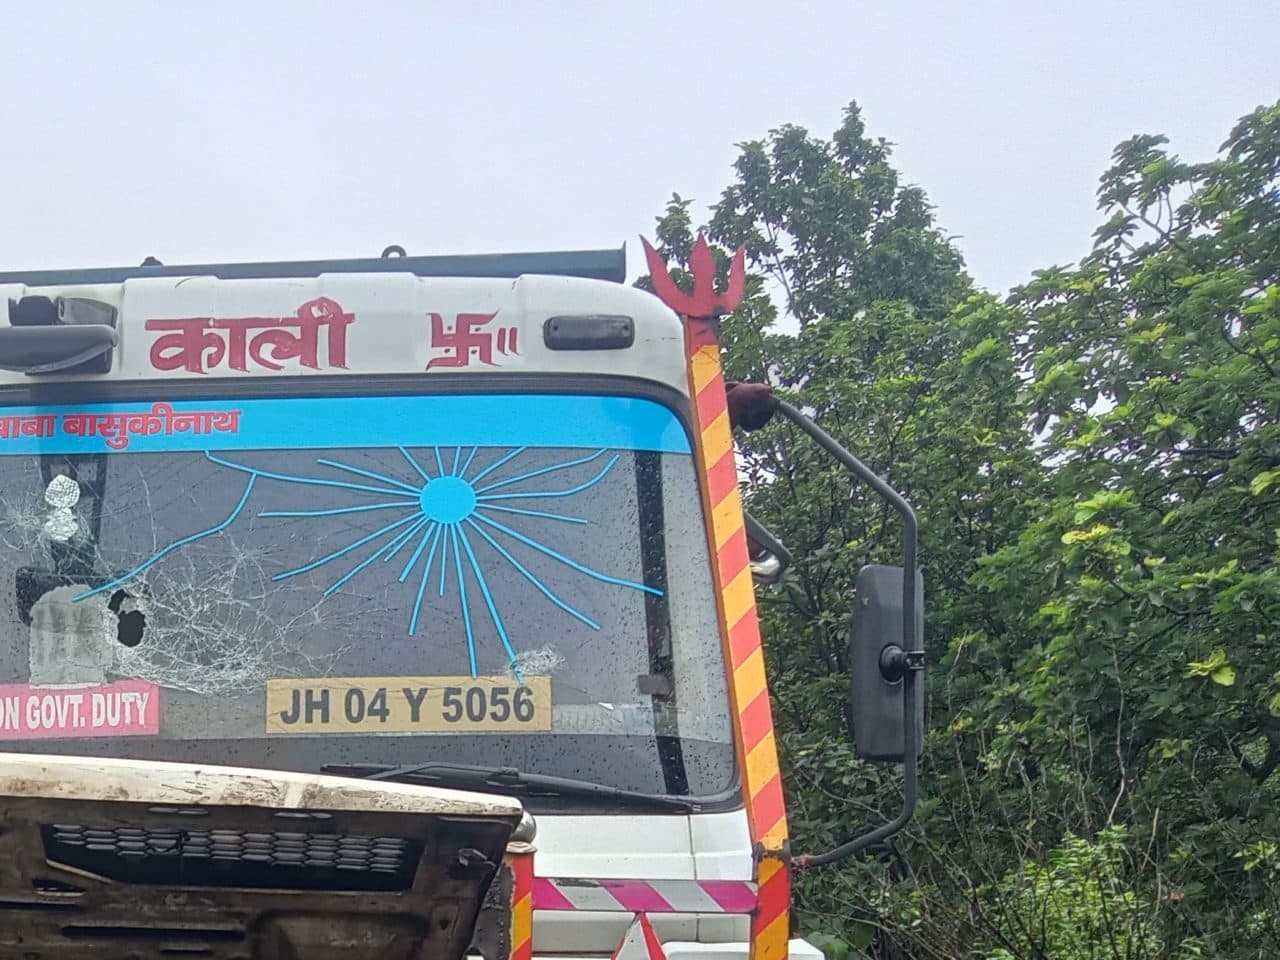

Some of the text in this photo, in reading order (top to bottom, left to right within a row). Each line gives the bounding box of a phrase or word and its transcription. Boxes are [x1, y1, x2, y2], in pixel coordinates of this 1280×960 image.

[145, 297, 356, 375] काली
[63, 402, 241, 450] बासुकीनाथ
[25, 694, 86, 730] GOVT.
[91, 691, 150, 728] DUTY
[280, 686, 535, 725] JH 04 Y 5056
